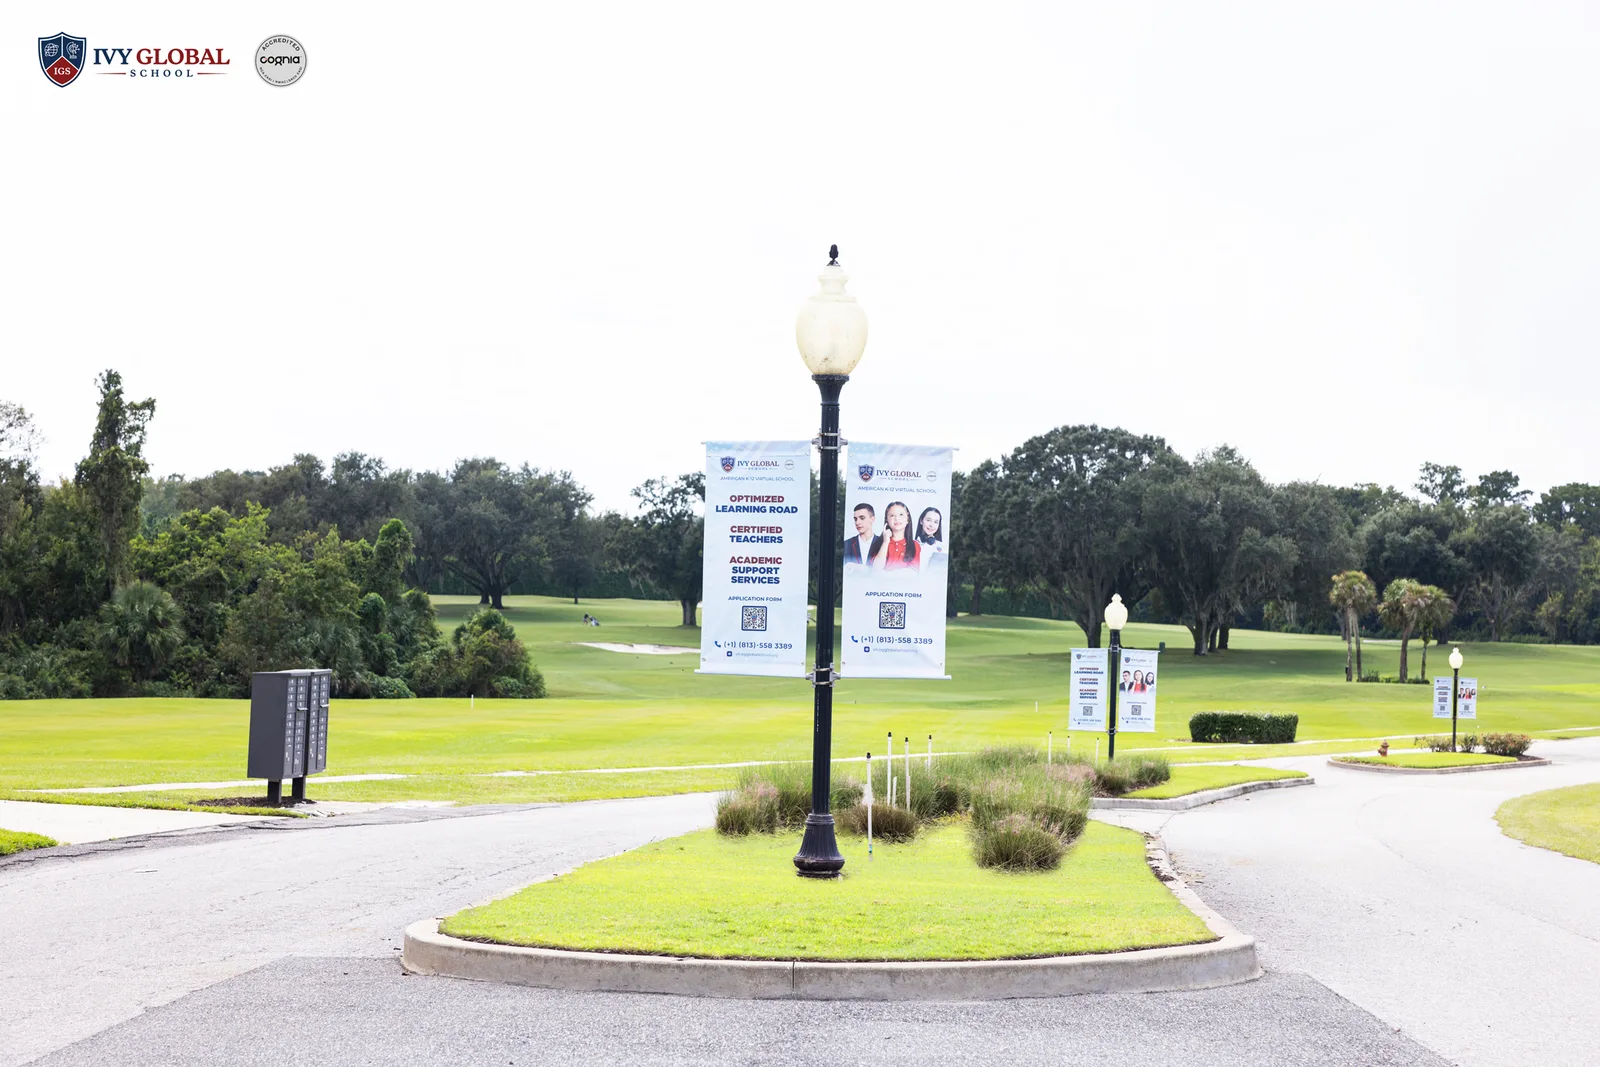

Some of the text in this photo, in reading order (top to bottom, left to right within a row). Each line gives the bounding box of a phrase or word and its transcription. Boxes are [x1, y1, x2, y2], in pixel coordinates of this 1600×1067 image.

[890, 470, 921, 478] GLOBAL
[716, 505, 766, 513] LEARNING
[730, 535, 783, 543] TEACHERS
[729, 556, 782, 564] ACADEMIC
[732, 566, 779, 574] SUPPORT
[731, 576, 780, 584] SERVICES
